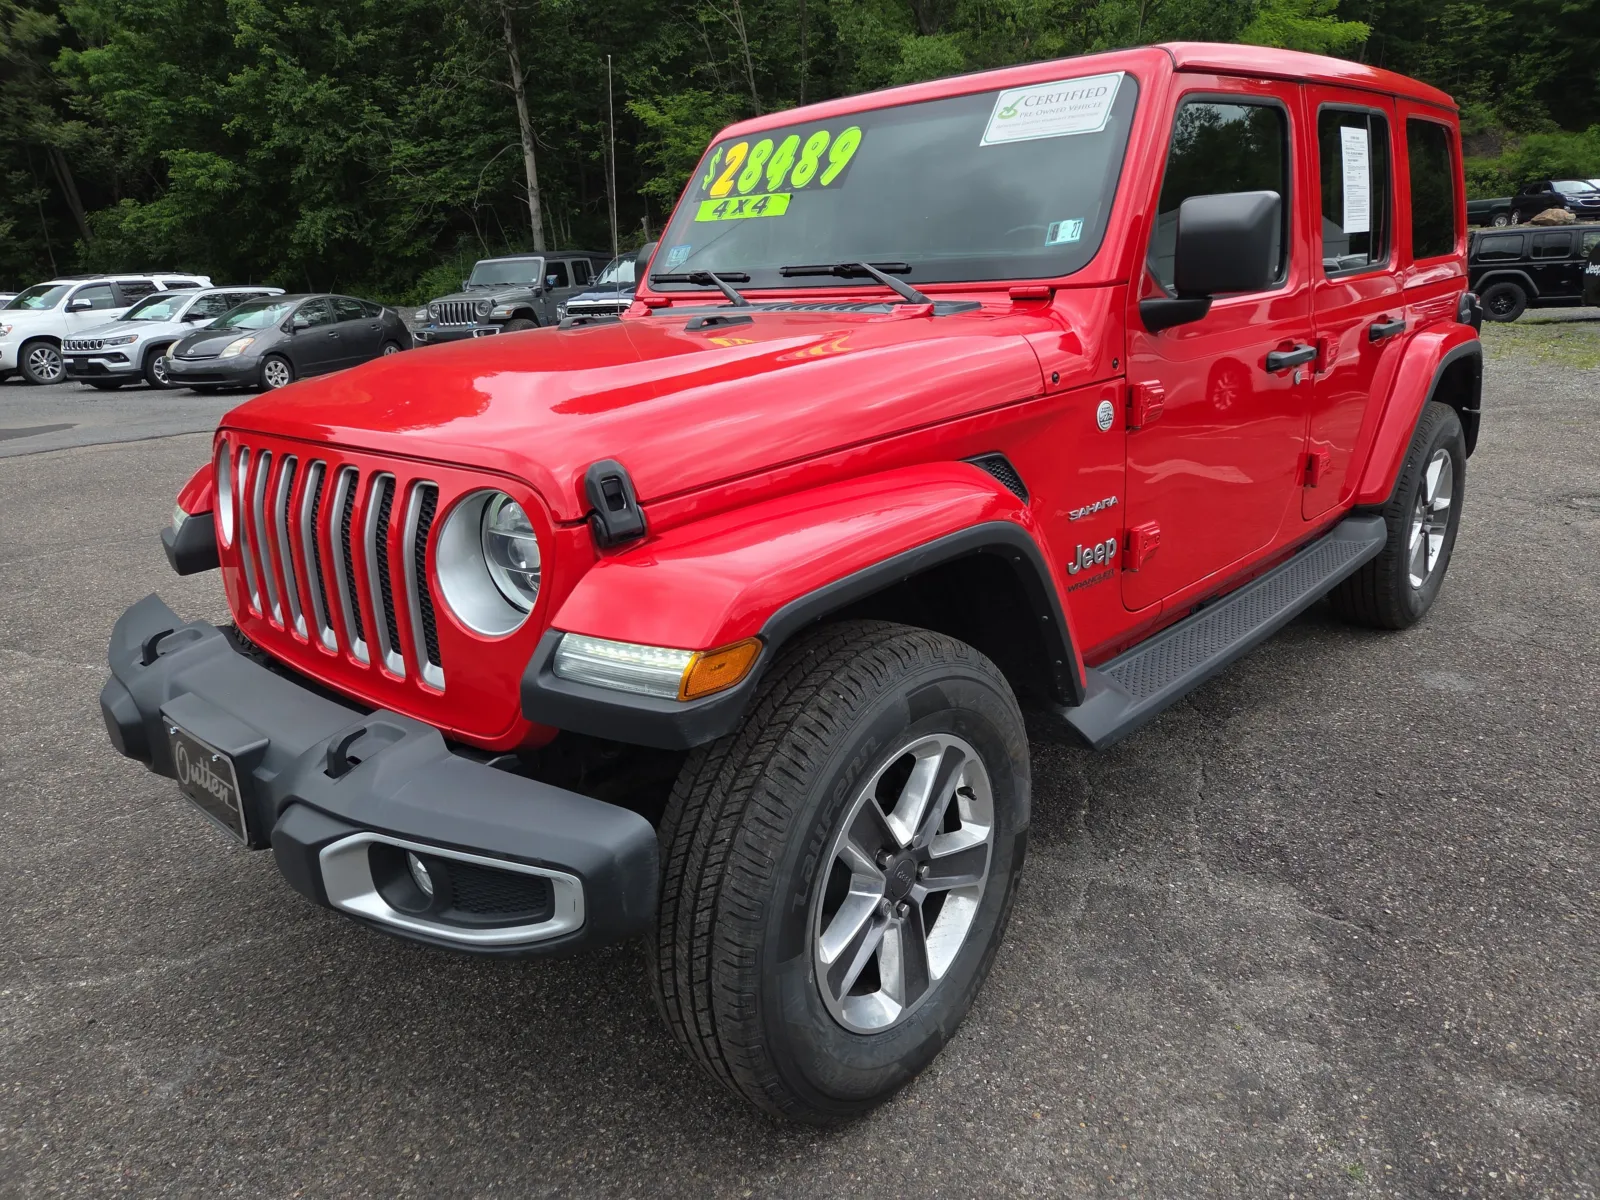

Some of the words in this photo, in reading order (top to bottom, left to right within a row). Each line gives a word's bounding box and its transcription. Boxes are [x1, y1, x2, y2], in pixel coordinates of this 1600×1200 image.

[1024, 87, 1108, 107] CERTIFIED
[701, 125, 862, 198] $28489
[1068, 495, 1119, 521] SAHARA
[1068, 537, 1117, 575] Jeep
[1067, 568, 1115, 592] WRANGLER
